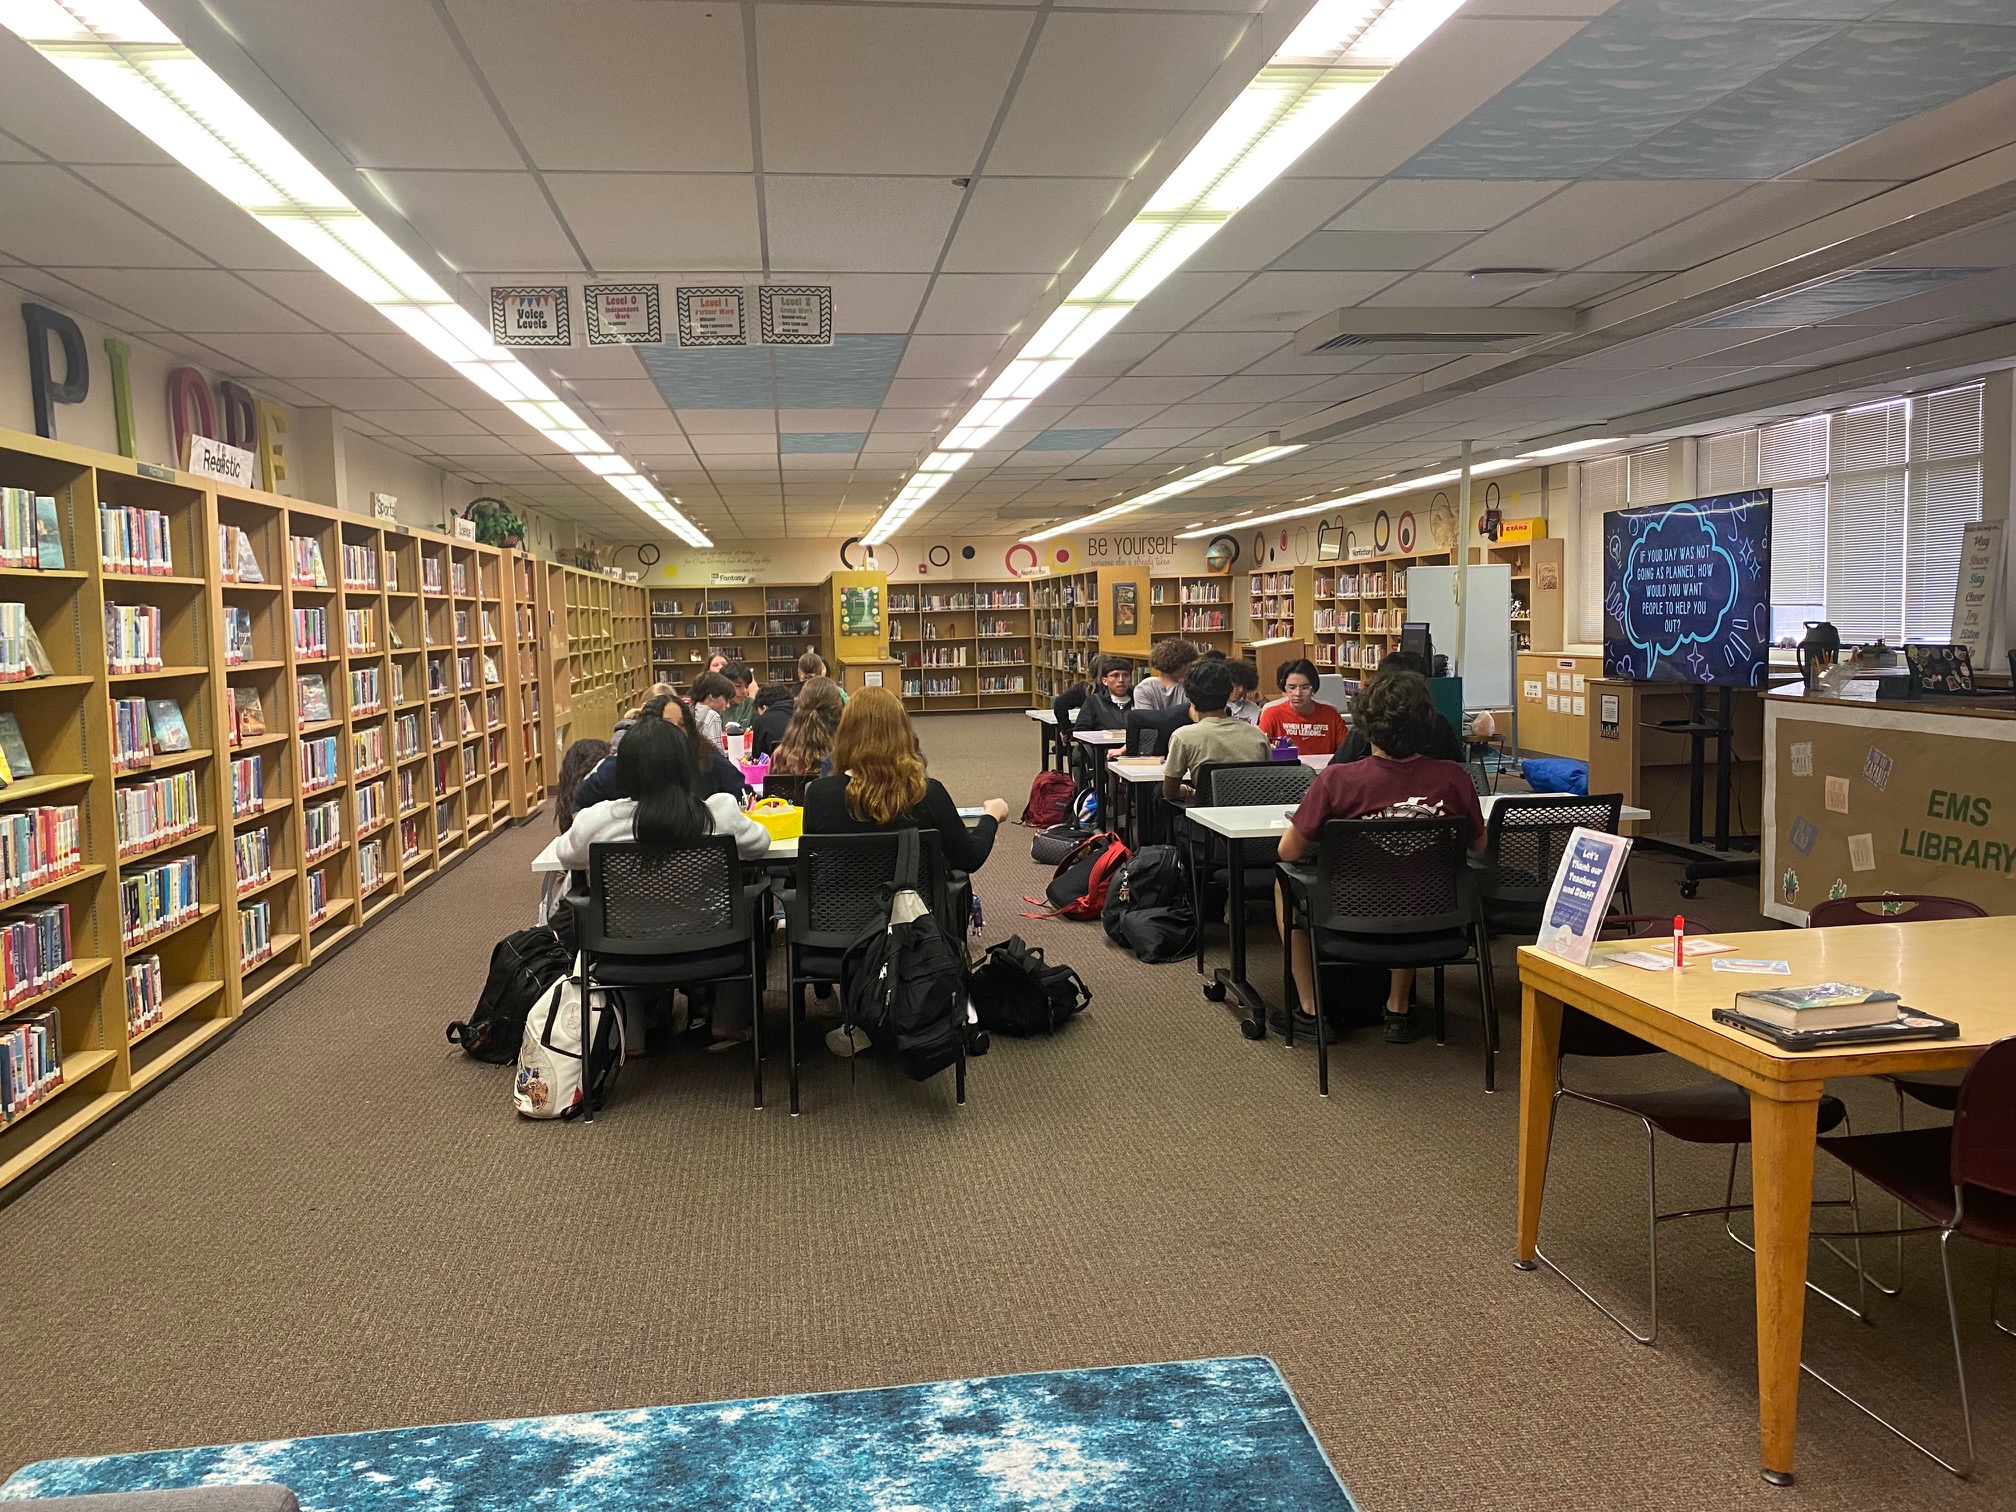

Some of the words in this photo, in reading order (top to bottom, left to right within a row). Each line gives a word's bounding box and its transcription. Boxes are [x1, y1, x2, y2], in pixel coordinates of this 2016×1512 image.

[605, 295, 627, 305] Level
[700, 298, 722, 308] Level
[781, 297, 802, 306] Level
[805, 297, 811, 306] 2
[516, 309, 545, 319] Voice
[605, 306, 639, 314] Independent
[517, 319, 548, 329] Levels
[203, 449, 241, 478] Realistic
[377, 499, 396, 518] Sports
[1974, 536, 1991, 548] Play
[1640, 551, 1646, 563] IF
[1647, 550, 1663, 563] YOUR
[1664, 548, 1677, 562] DAY
[1679, 547, 1695, 560] WAS
[1697, 545, 1710, 558] NOT
[1969, 555, 1991, 565] Share
[719, 574, 746, 582] Fantasy
[1637, 567, 1654, 580] GOING
[1656, 566, 1664, 579] AS
[1665, 565, 1696, 579] PLANNED,
[1697, 563, 1713, 577] HOW
[1969, 573, 1985, 586] Sing
[1646, 584, 1666, 597] WOULD
[1668, 583, 1681, 597] YOU
[1682, 582, 1703, 596] WANT
[1965, 592, 1985, 603] Cheer
[1642, 602, 1663, 615] PEOPLE
[1665, 601, 1673, 615] TO
[1675, 601, 1691, 615] HELP
[1692, 601, 1707, 615] YOU
[1967, 610, 1979, 623] Try
[1664, 619, 1681, 633] OUT?
[1959, 629, 1980, 639] Listen
[1793, 756, 1811, 773] SMART
[1865, 760, 1888, 787] CAPABLE
[1927, 790, 1991, 826] EMS
[1793, 828, 1809, 849] KIND
[1582, 848, 1599, 861] Let's
[1900, 829, 2016, 873] LIBRARY
[1572, 860, 1590, 873] Thank
[1590, 867, 1603, 875] our
[1568, 872, 1597, 888] Teachers
[1562, 886, 1575, 896] and
[1574, 887, 1595, 901] Staff!
